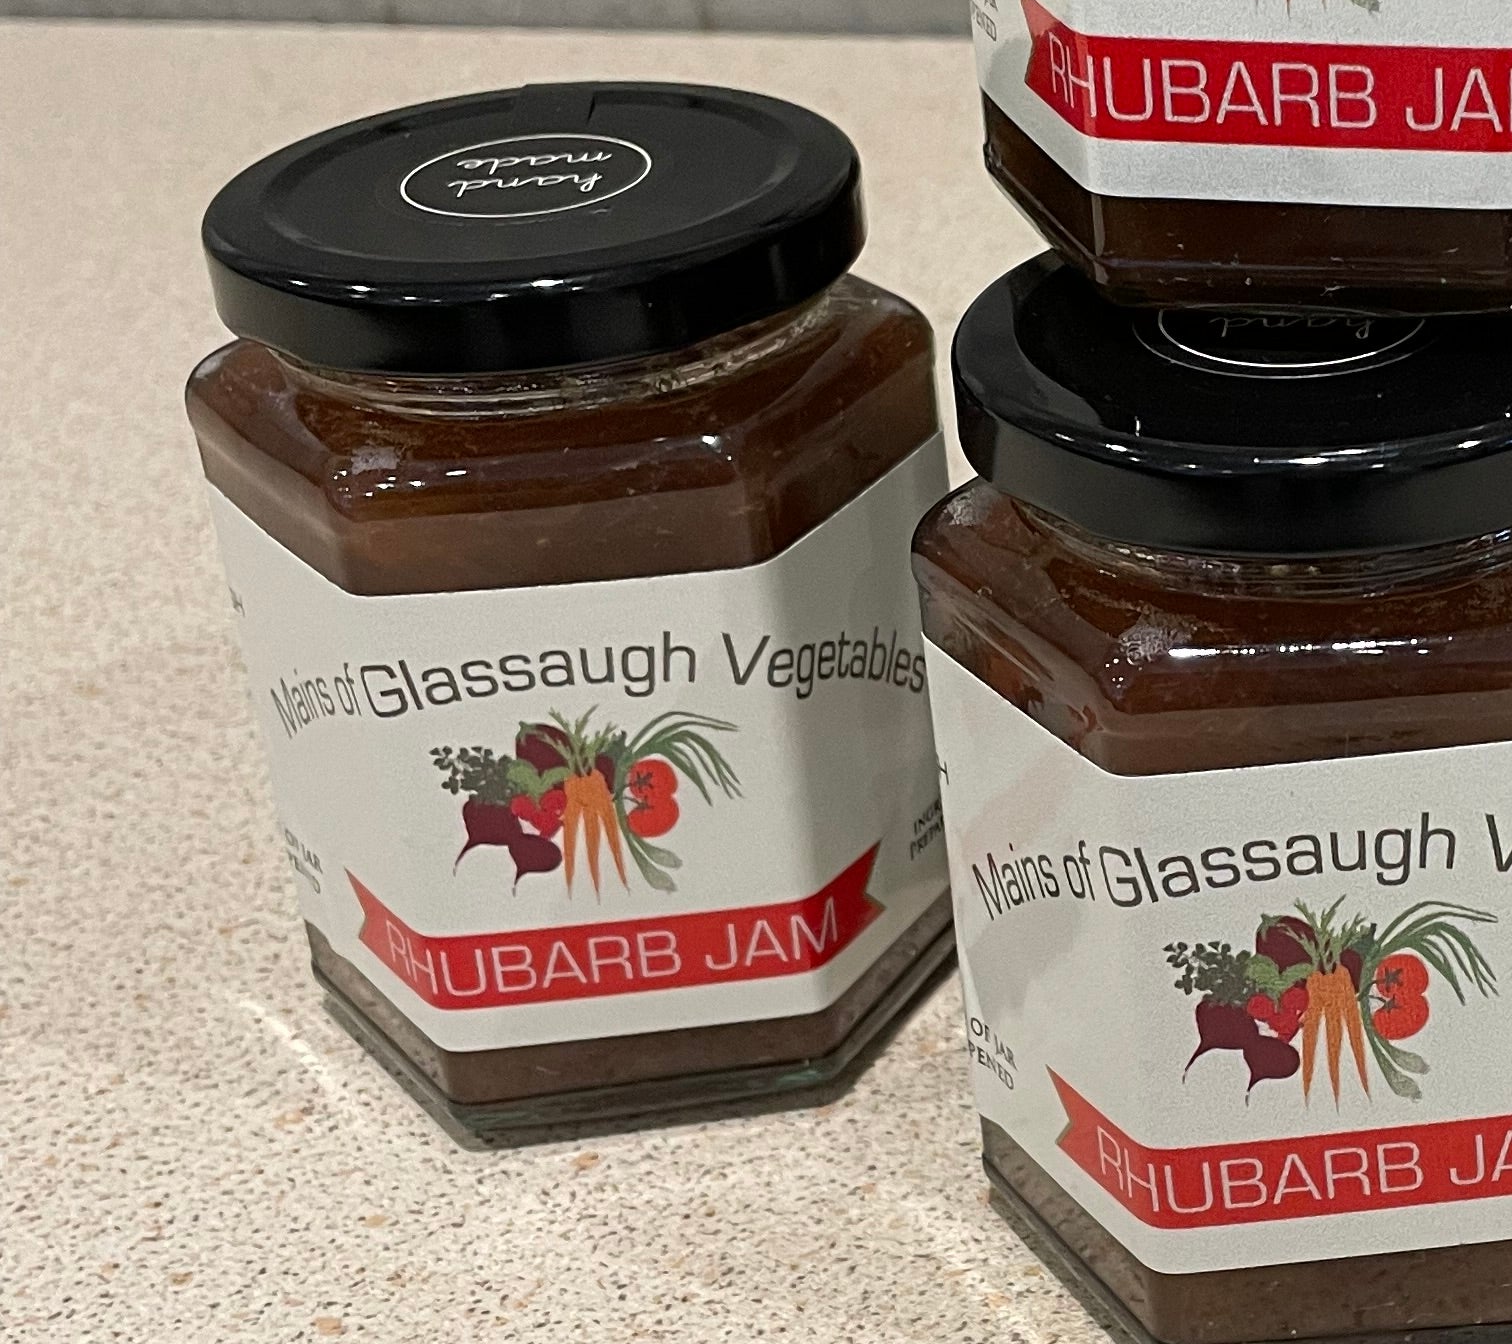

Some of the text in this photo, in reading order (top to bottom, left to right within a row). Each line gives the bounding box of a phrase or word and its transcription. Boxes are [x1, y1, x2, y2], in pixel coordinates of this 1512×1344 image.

[1049, 32, 1378, 132] RHUBARB
[448, 171, 602, 198] hand
[457, 151, 613, 176] made
[271, 627, 927, 739] Mains of Glassaugh Vegetables
[973, 841, 1060, 923] Mains
[1065, 838, 1097, 901] of
[1099, 812, 1456, 908] Glassaugh
[387, 897, 840, 998] RHUBARB JAM
[967, 1039, 1015, 1090] PENED
[1096, 1126, 1425, 1213] RHUBARB
